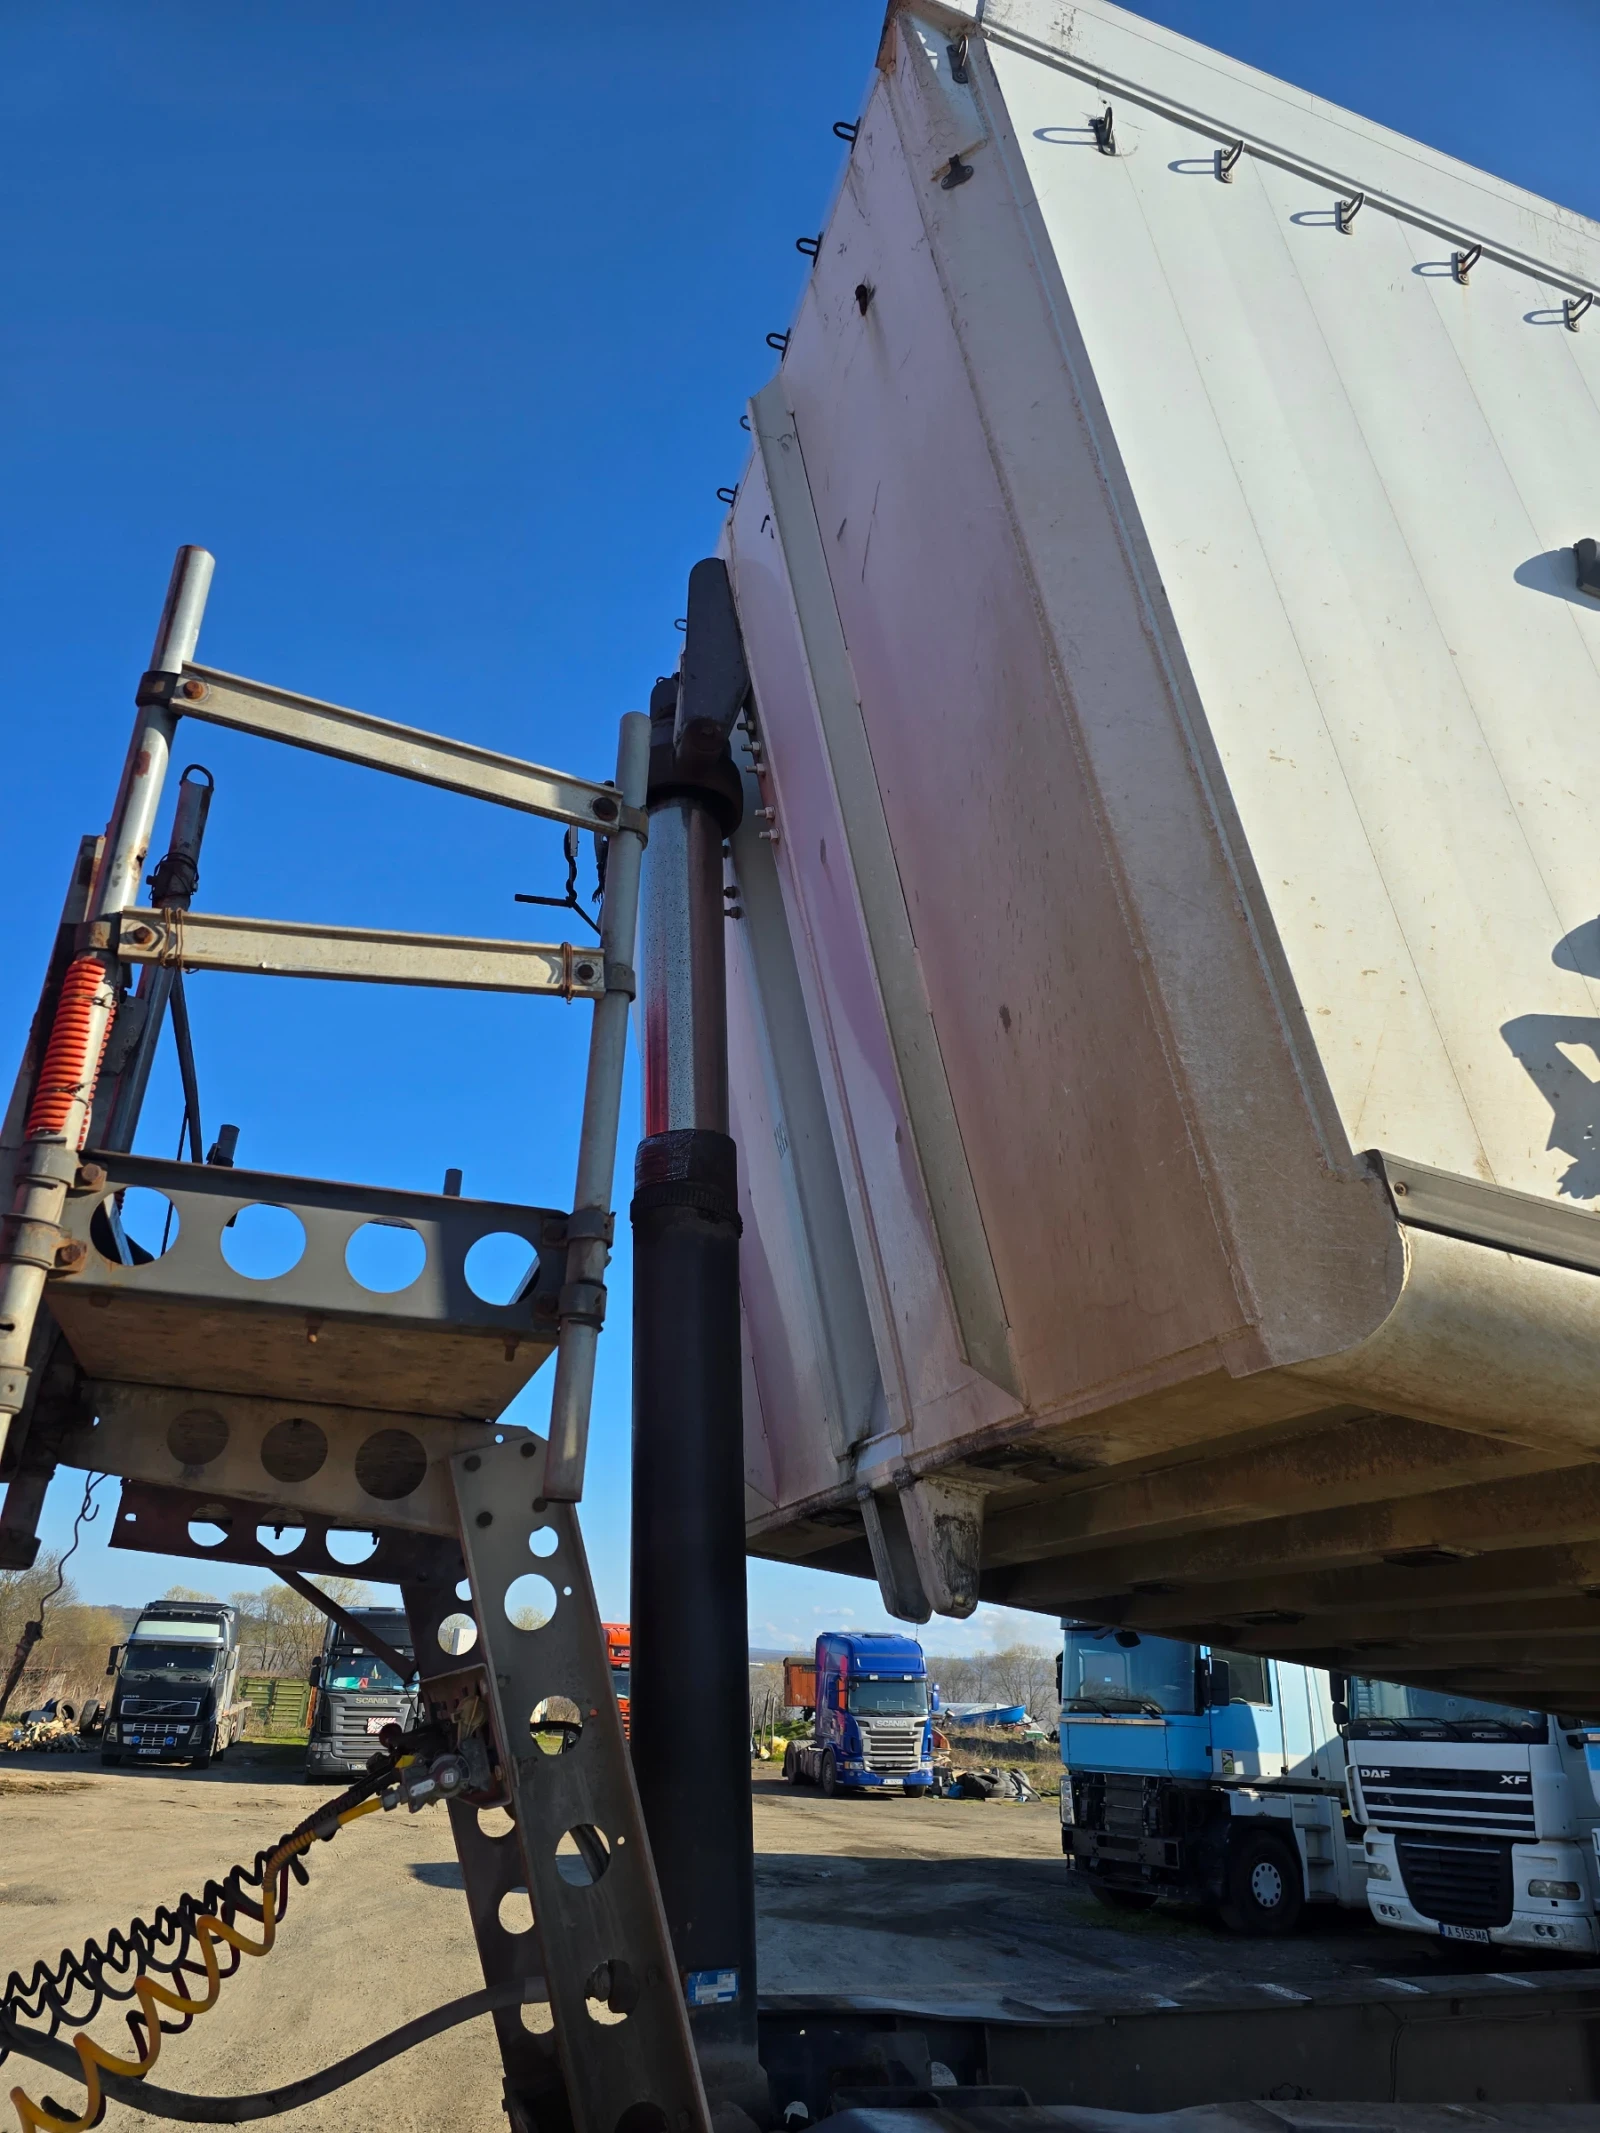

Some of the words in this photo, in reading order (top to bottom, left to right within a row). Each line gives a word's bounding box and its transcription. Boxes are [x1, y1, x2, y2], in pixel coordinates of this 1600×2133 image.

[876, 1719, 908, 1728] SCANIA
[1360, 1768, 1391, 1779] DAF
[1499, 1774, 1528, 1785] XF
